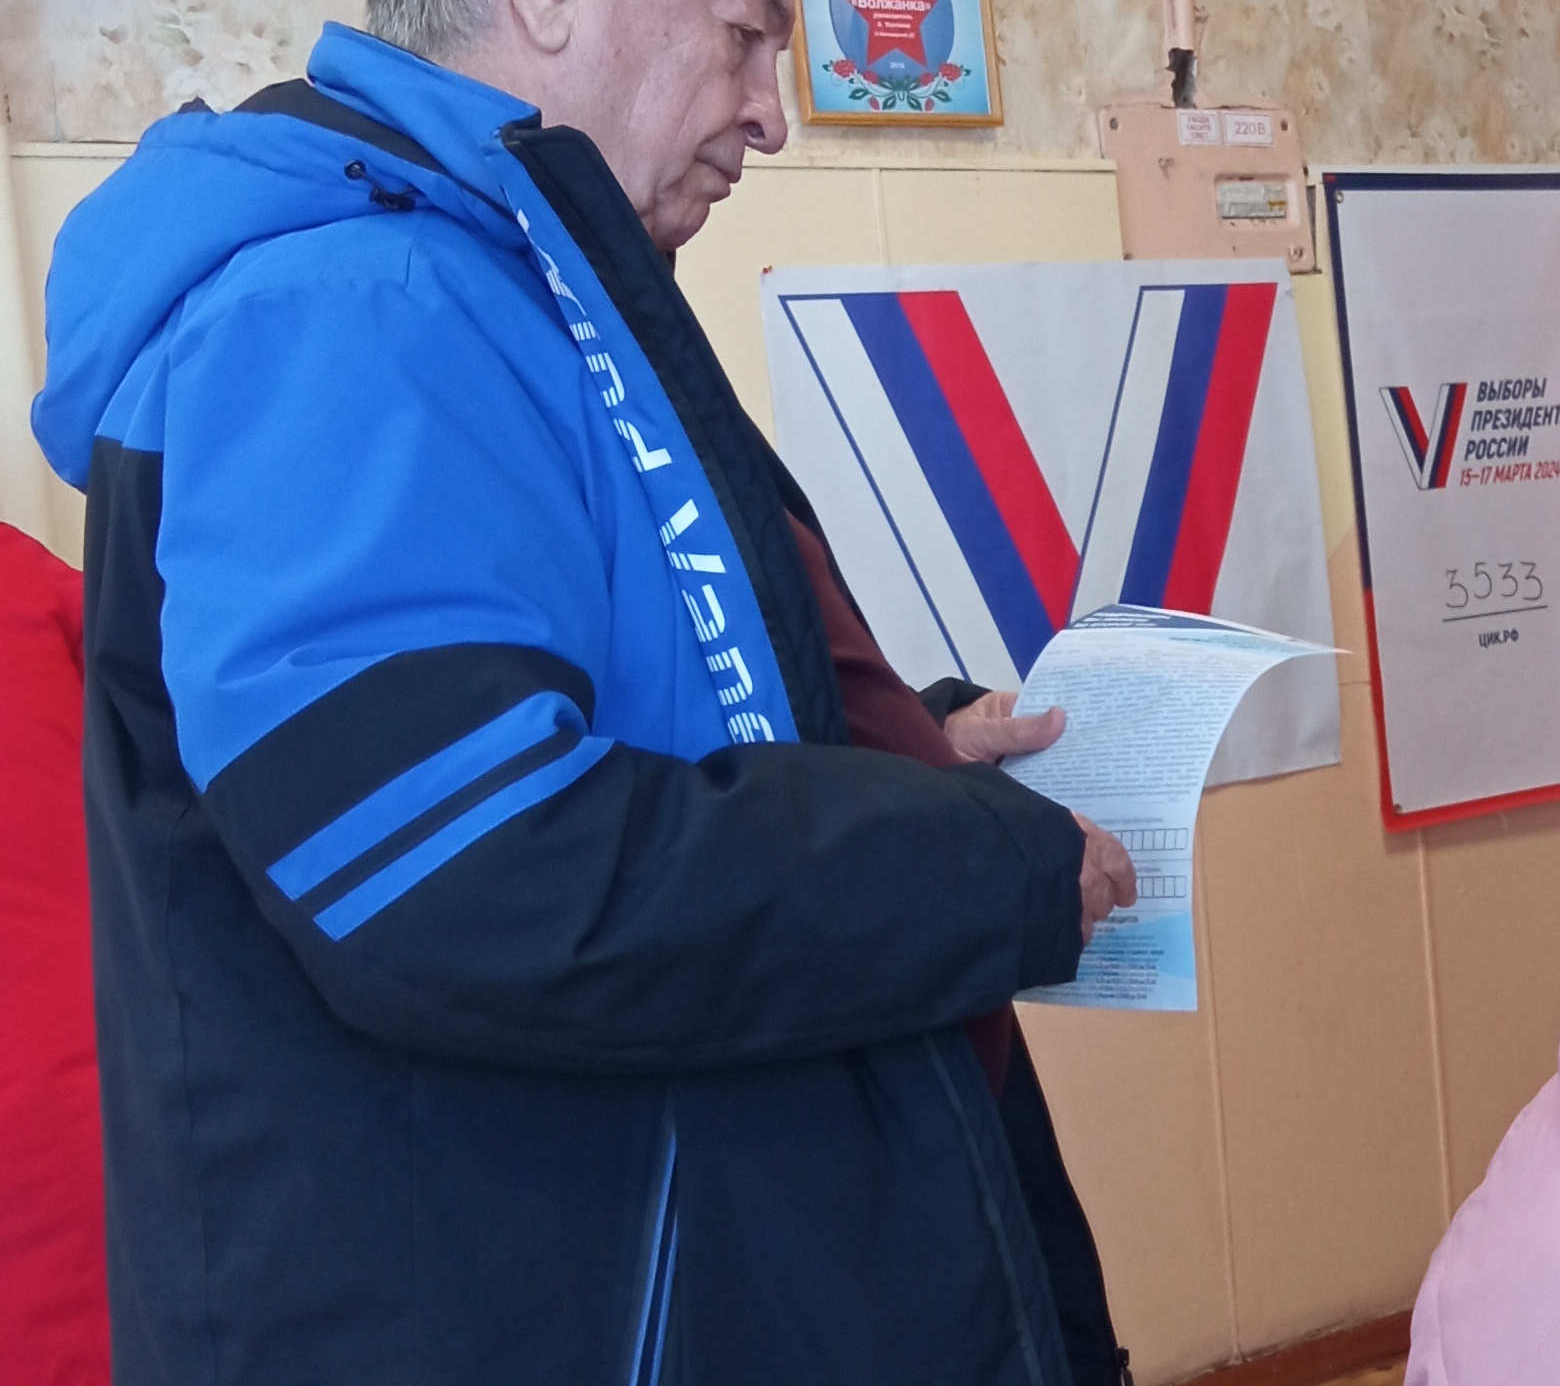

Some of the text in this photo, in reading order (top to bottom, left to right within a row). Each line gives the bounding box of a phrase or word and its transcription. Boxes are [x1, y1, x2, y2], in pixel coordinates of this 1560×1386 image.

[1476, 377, 1547, 403] ВЫБОРЫ
[1464, 435, 1530, 462] РОССИИ
[1493, 463, 1532, 483] МАРТА
[1445, 560, 1543, 609] 3533
[1478, 628, 1520, 648] ЦИК.РФ
